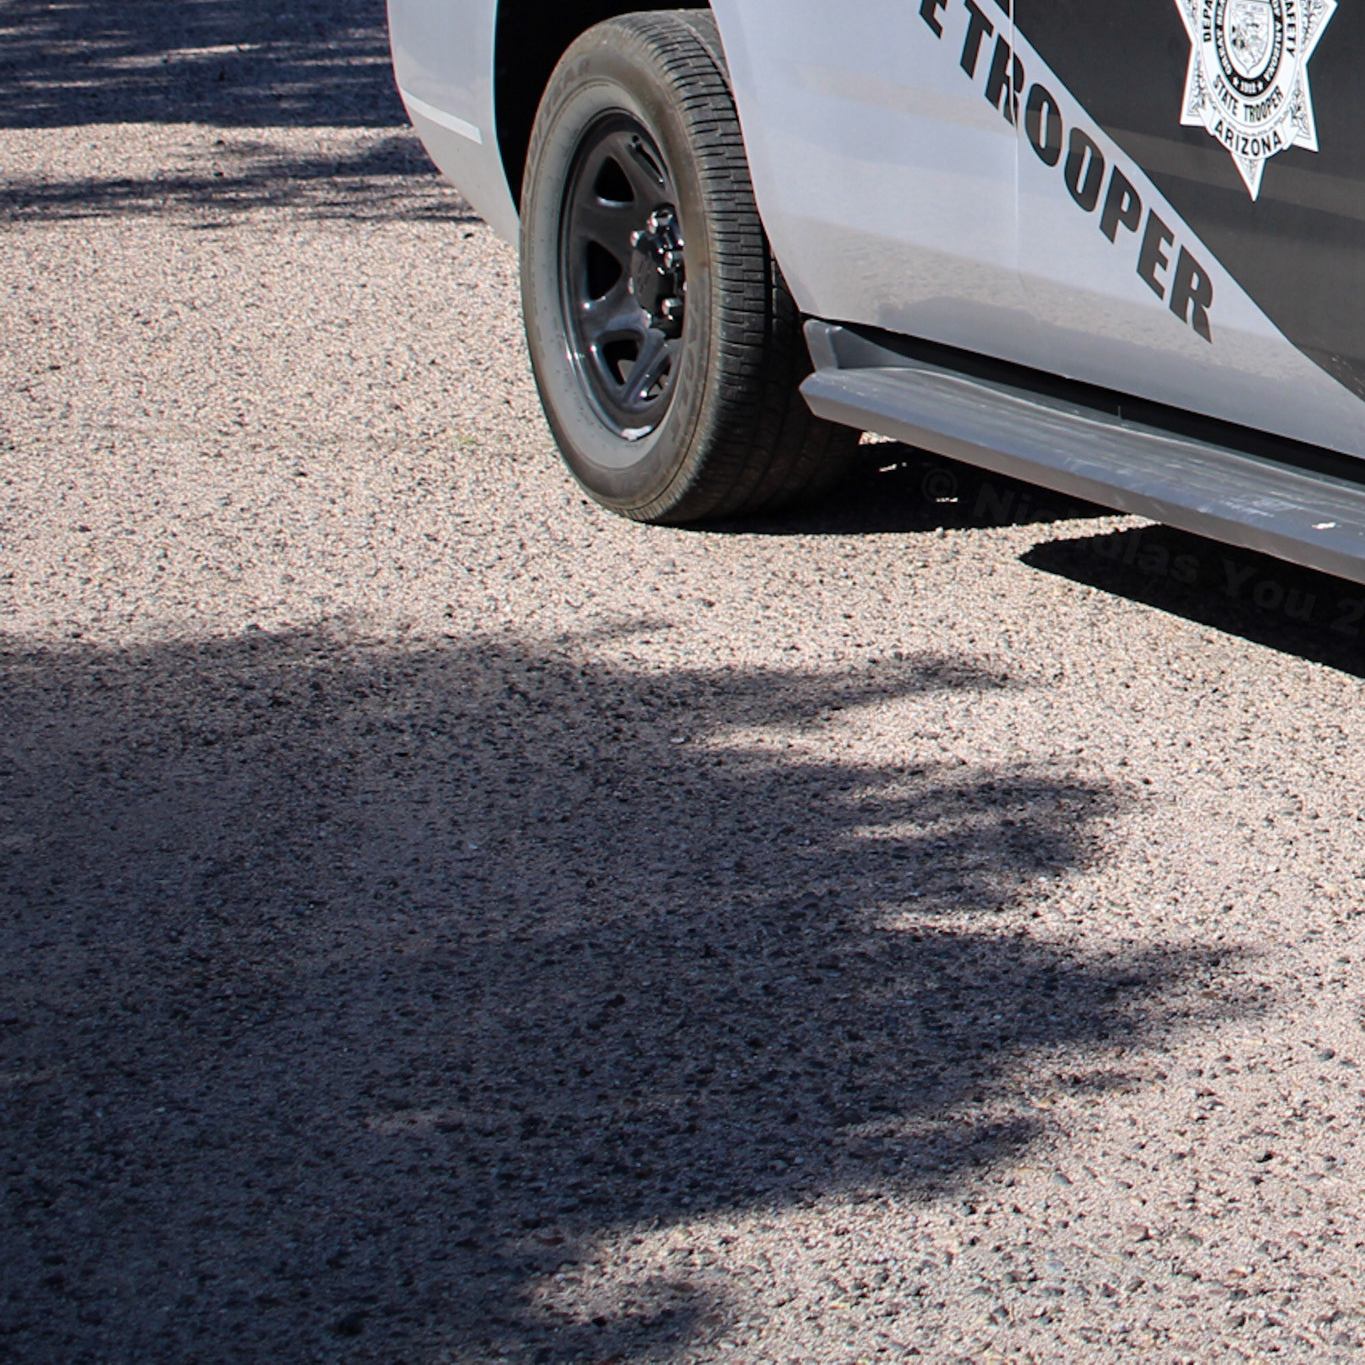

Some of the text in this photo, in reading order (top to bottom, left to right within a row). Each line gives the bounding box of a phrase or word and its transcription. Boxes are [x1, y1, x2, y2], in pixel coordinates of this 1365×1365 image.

[1213, 73, 1284, 123] STATE TROOPER
[1214, 119, 1282, 157] ARIZONA
